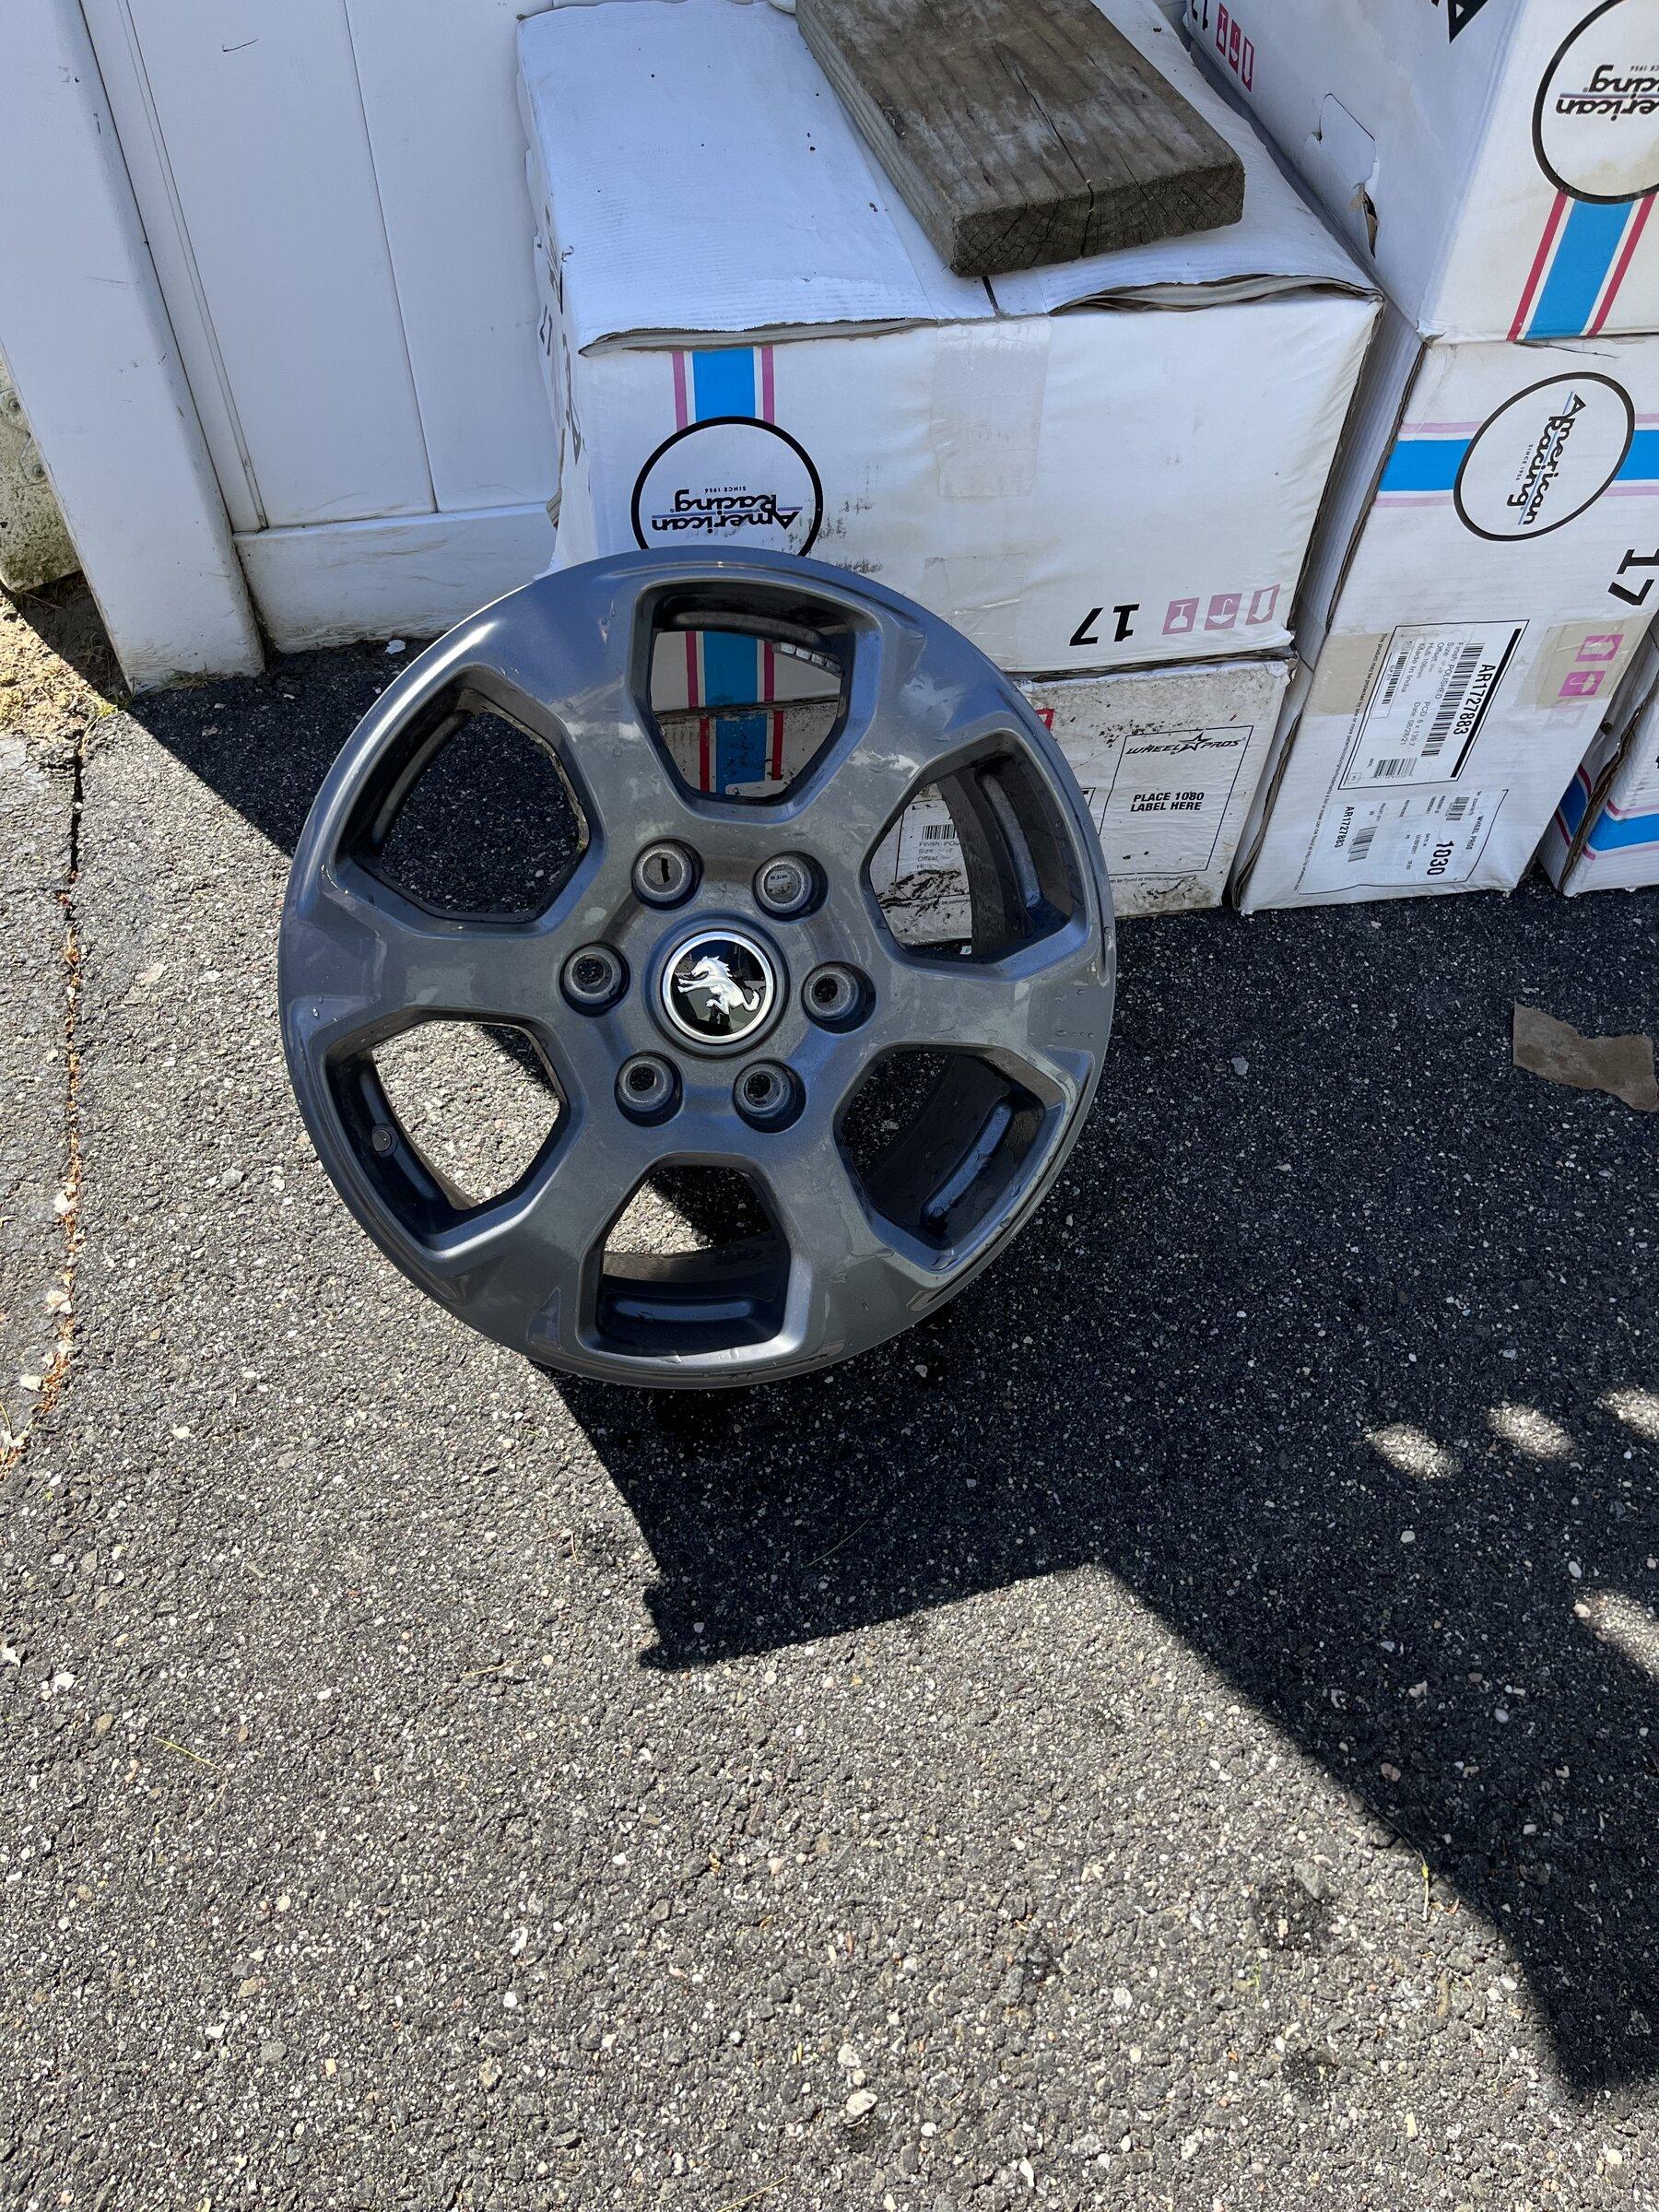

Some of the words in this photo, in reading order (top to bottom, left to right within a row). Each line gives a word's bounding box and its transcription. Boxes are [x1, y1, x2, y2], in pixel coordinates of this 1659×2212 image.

[1589, 65, 1659, 99] cing
[1556, 98, 1659, 122] erican
[1507, 416, 1571, 507] Racing
[1522, 394, 1587, 525] American
[674, 488, 777, 513] Racing
[651, 510, 800, 534] American
[1607, 548, 1659, 606] 17
[1069, 603, 1140, 646] 17
[1453, 664, 1497, 735] AR1727883
[1125, 744, 1181, 755] WHEEL
[1200, 739, 1242, 749] PROS
[1130, 802, 1167, 812] LABEL
[1170, 802, 1203, 811] HERE
[1133, 792, 1171, 803] PLACE
[1175, 791, 1206, 801] 1080
[1334, 806, 1355, 848] AR1727883
[1427, 841, 1454, 876] 1030
